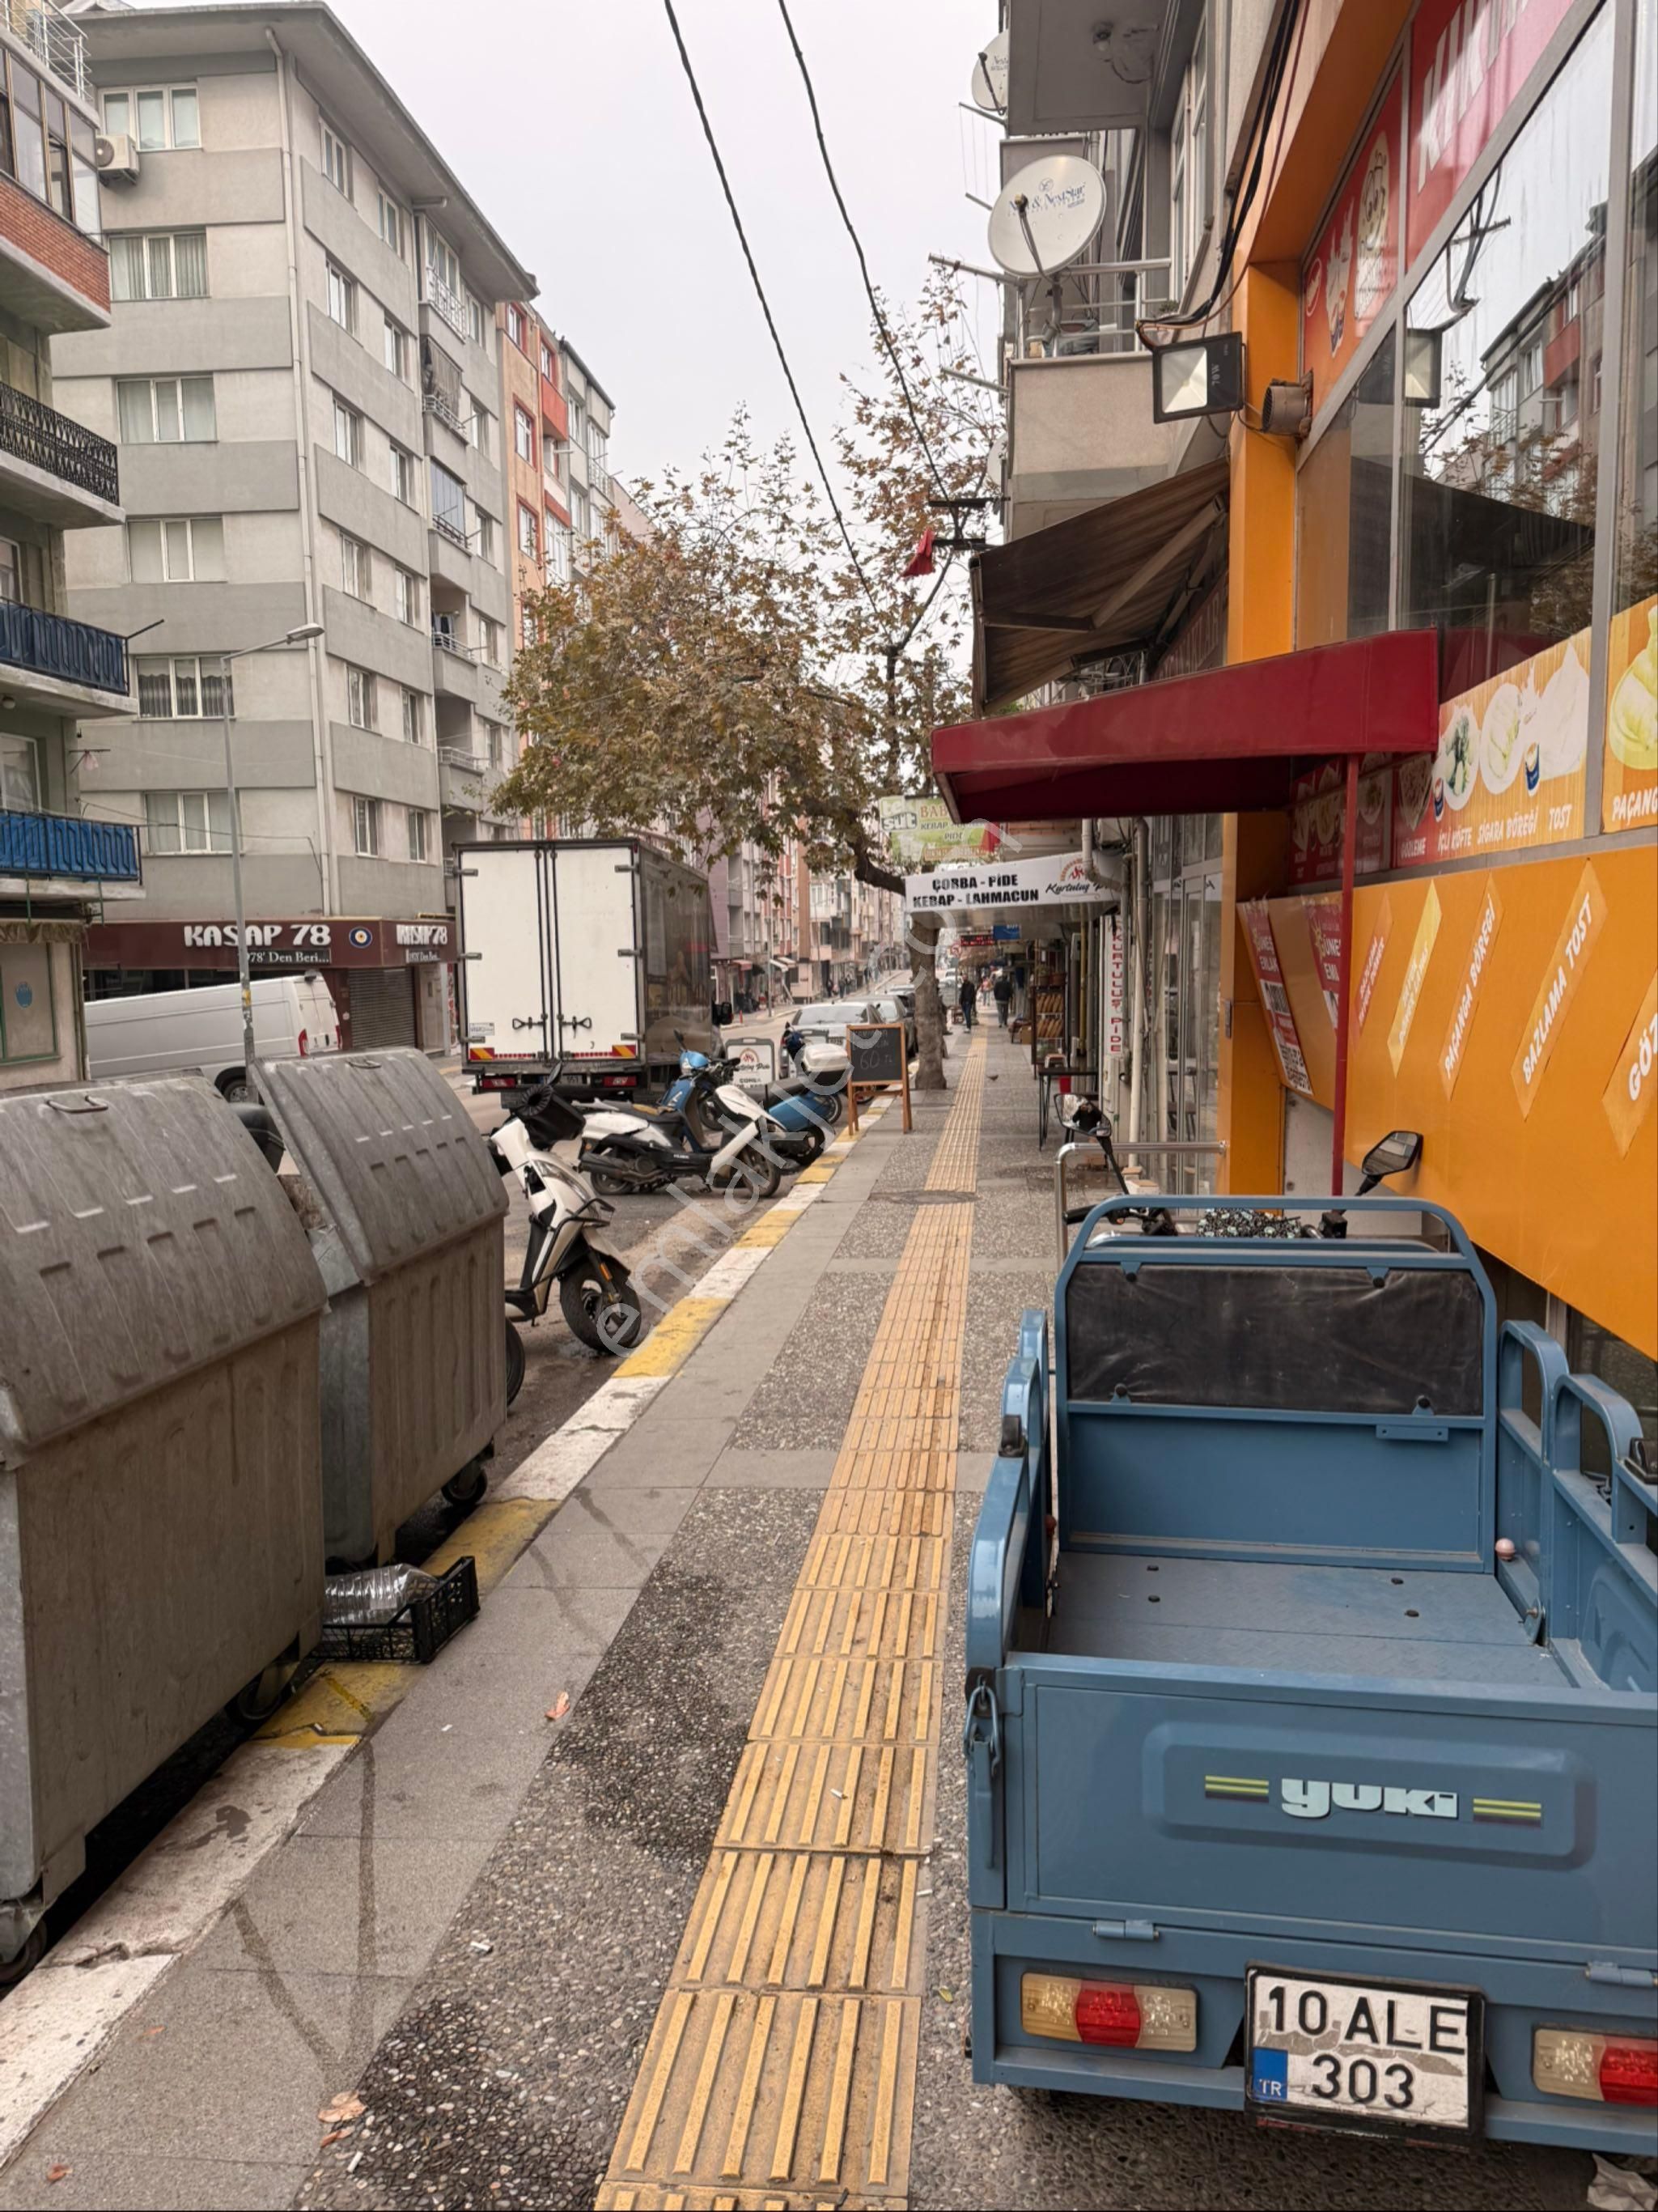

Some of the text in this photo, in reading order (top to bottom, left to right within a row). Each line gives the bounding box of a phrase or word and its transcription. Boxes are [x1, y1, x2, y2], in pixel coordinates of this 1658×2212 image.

[1506, 805, 1540, 840] BÖREĞİ
[1548, 804, 1573, 831] TOST
[932, 877, 977, 892] ÇORBA
[988, 873, 1019, 887] PİDE
[913, 894, 955, 908] KEBAP
[965, 889, 1039, 905] LAHMACUN
[184, 924, 331, 946] KASAP 78
[431, 925, 448, 945] 78
[269, 952, 292, 962] Den
[1523, 892, 1592, 1085] BAZLAMA TOST
[1269, 1985, 1465, 2055] 10 ALE
[1259, 2078, 1283, 2097] TR
[1312, 2054, 1414, 2108] 303
